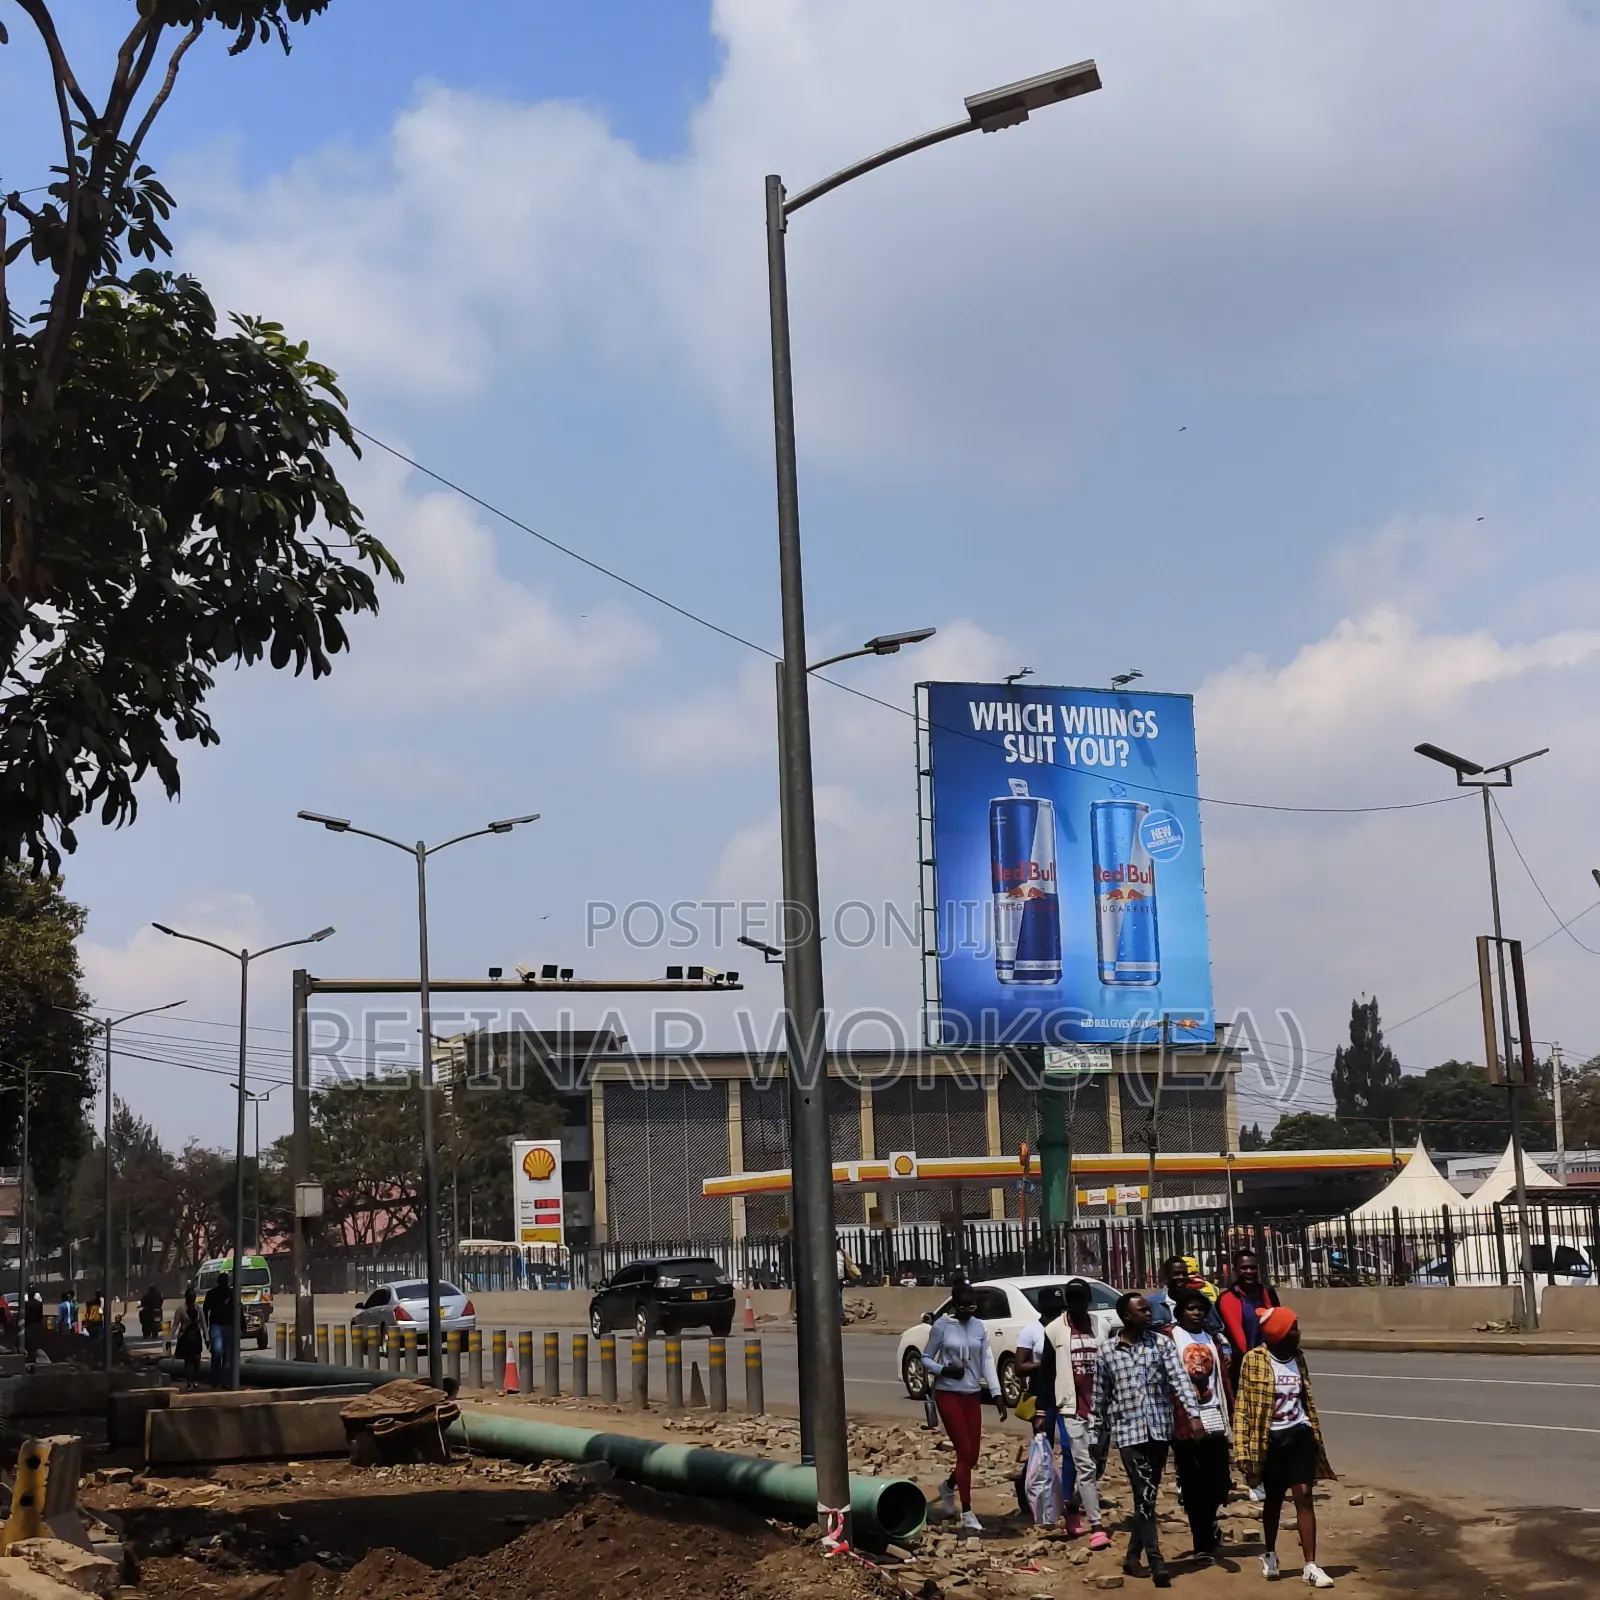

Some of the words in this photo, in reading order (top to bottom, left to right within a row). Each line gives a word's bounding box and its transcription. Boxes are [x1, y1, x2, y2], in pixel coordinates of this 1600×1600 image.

[969, 701, 1054, 733] WHICH
[1060, 705, 1159, 739] WIIINGS
[1003, 734, 1057, 764] SUIT
[1063, 736, 1130, 768] YOU?
[1150, 824, 1172, 841] NEW
